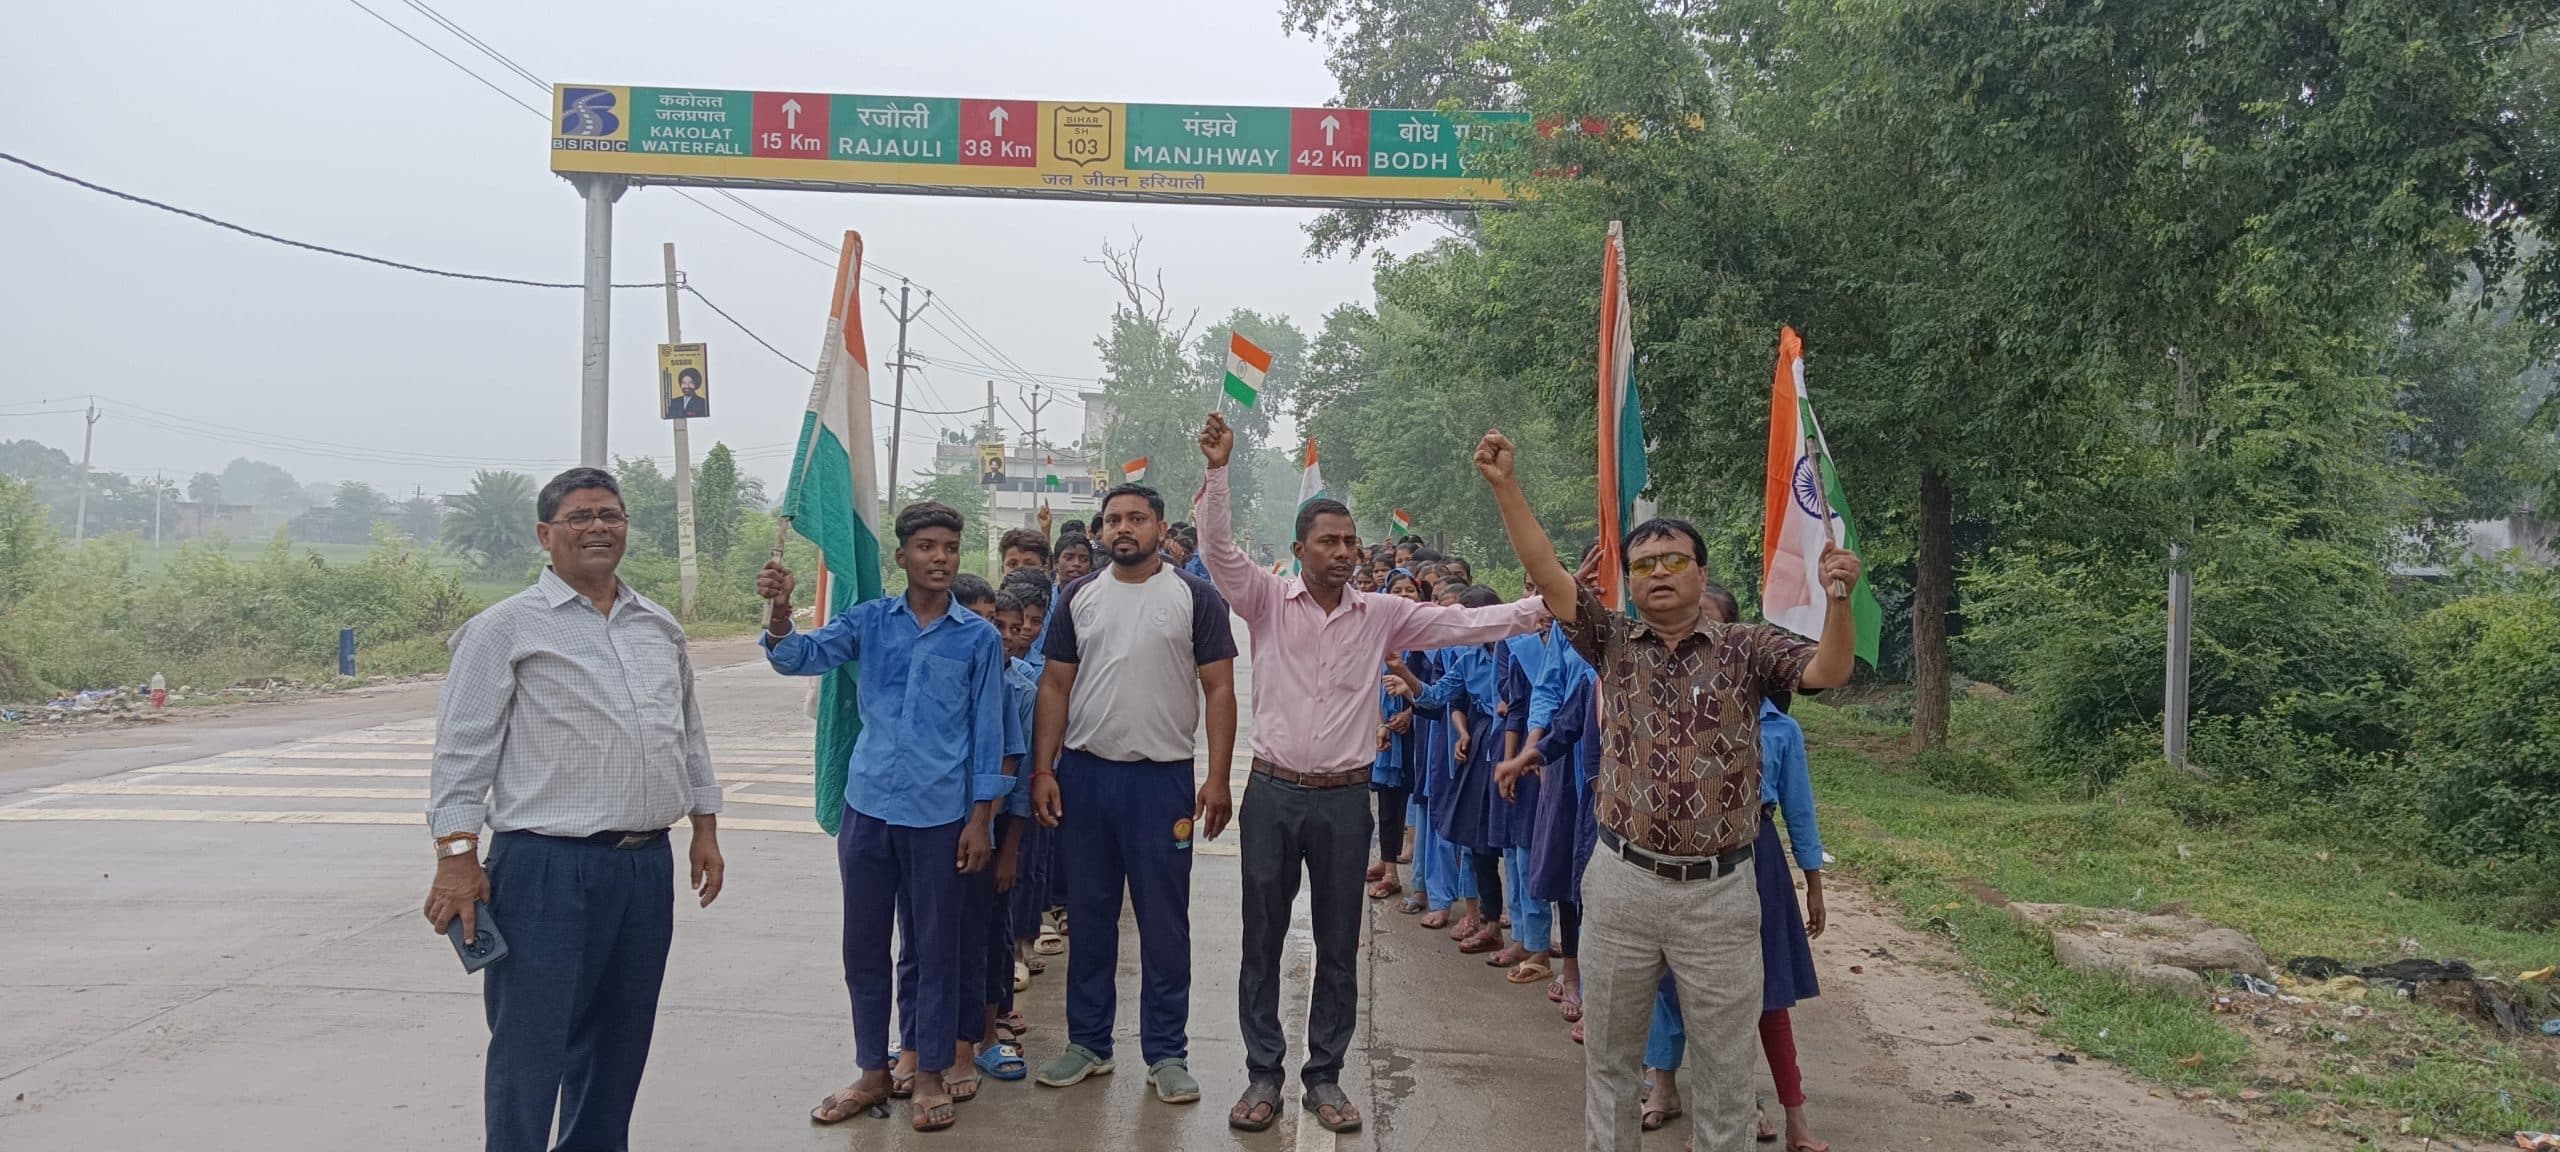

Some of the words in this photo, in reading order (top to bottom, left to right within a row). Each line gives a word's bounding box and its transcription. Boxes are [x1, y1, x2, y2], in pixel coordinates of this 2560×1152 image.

[659, 92, 723, 108] ककोलत
[655, 109, 726, 123] जलप्रपात
[857, 102, 930, 129] रजौली
[1066, 116, 1100, 125] BIHAR
[1183, 112, 1237, 137] मंझवे
[650, 126, 733, 140] KAKOLAT
[1074, 127, 1090, 136] SH
[1398, 116, 1440, 144] बोध
[642, 140, 744, 156] WATERFALL
[761, 132, 783, 150] 15
[790, 134, 821, 151] Km
[839, 136, 941, 158] RAJAULI
[965, 140, 993, 157] 38
[1000, 141, 1032, 158] Km
[1066, 138, 1099, 155] 103
[1134, 145, 1280, 167] MANJHWAY
[1296, 149, 1324, 167] 42
[1332, 150, 1362, 168] Km
[1374, 151, 1448, 171] BODH
[1041, 173, 1073, 186] जल
[1083, 171, 1128, 188] जीवन
[1138, 173, 1206, 190] हरियाली
